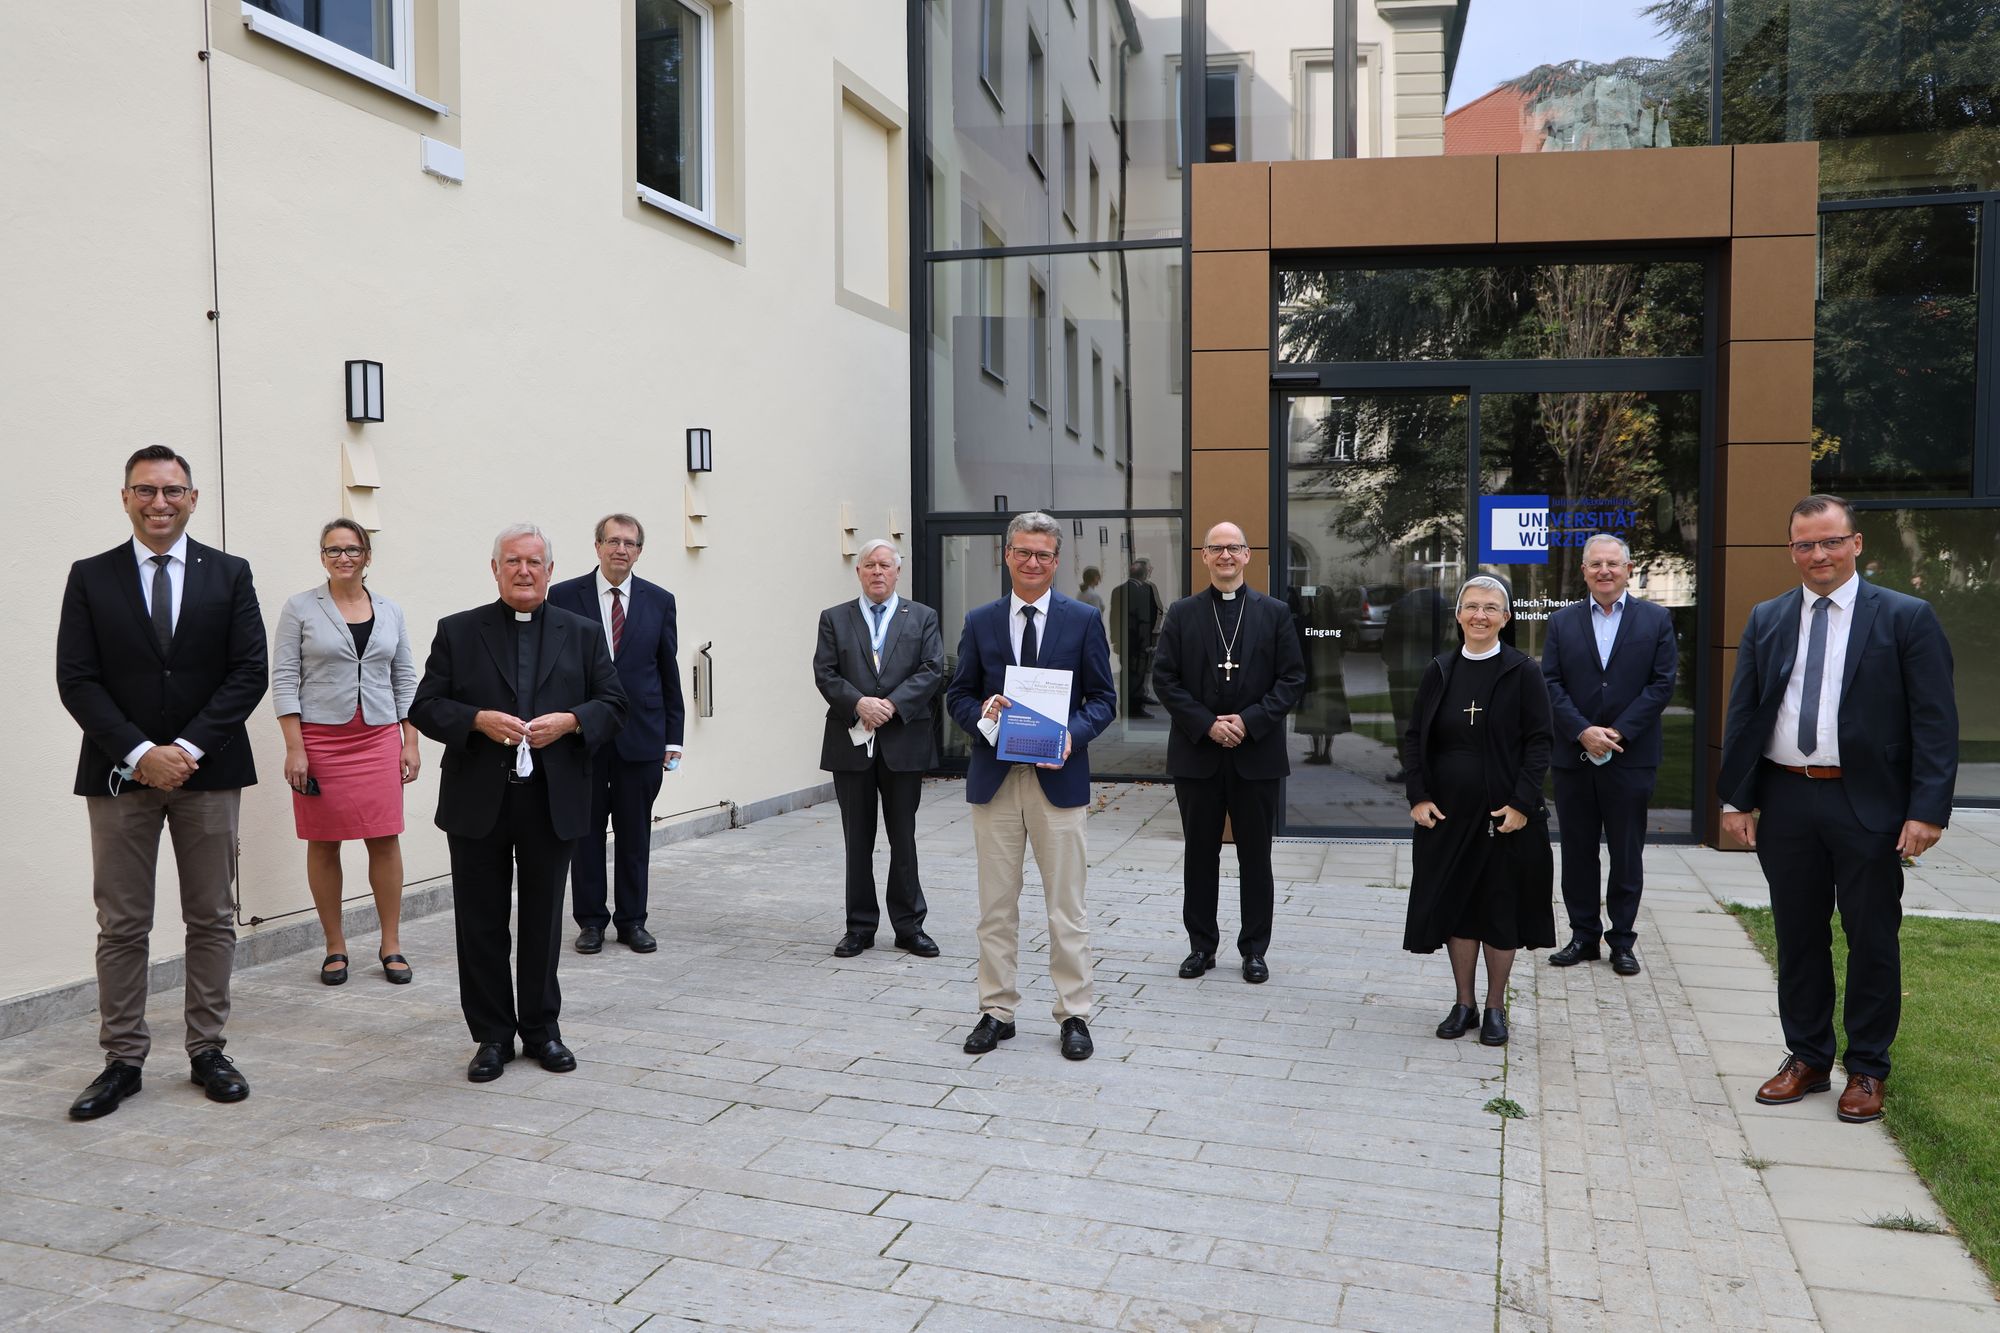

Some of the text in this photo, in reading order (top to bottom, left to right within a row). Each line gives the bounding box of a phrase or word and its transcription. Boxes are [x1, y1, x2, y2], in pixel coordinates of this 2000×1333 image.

[1518, 509, 1638, 528] UNIVERSITÄT
[1514, 611, 1551, 620] bliothe
[1305, 627, 1342, 638] Eingang
